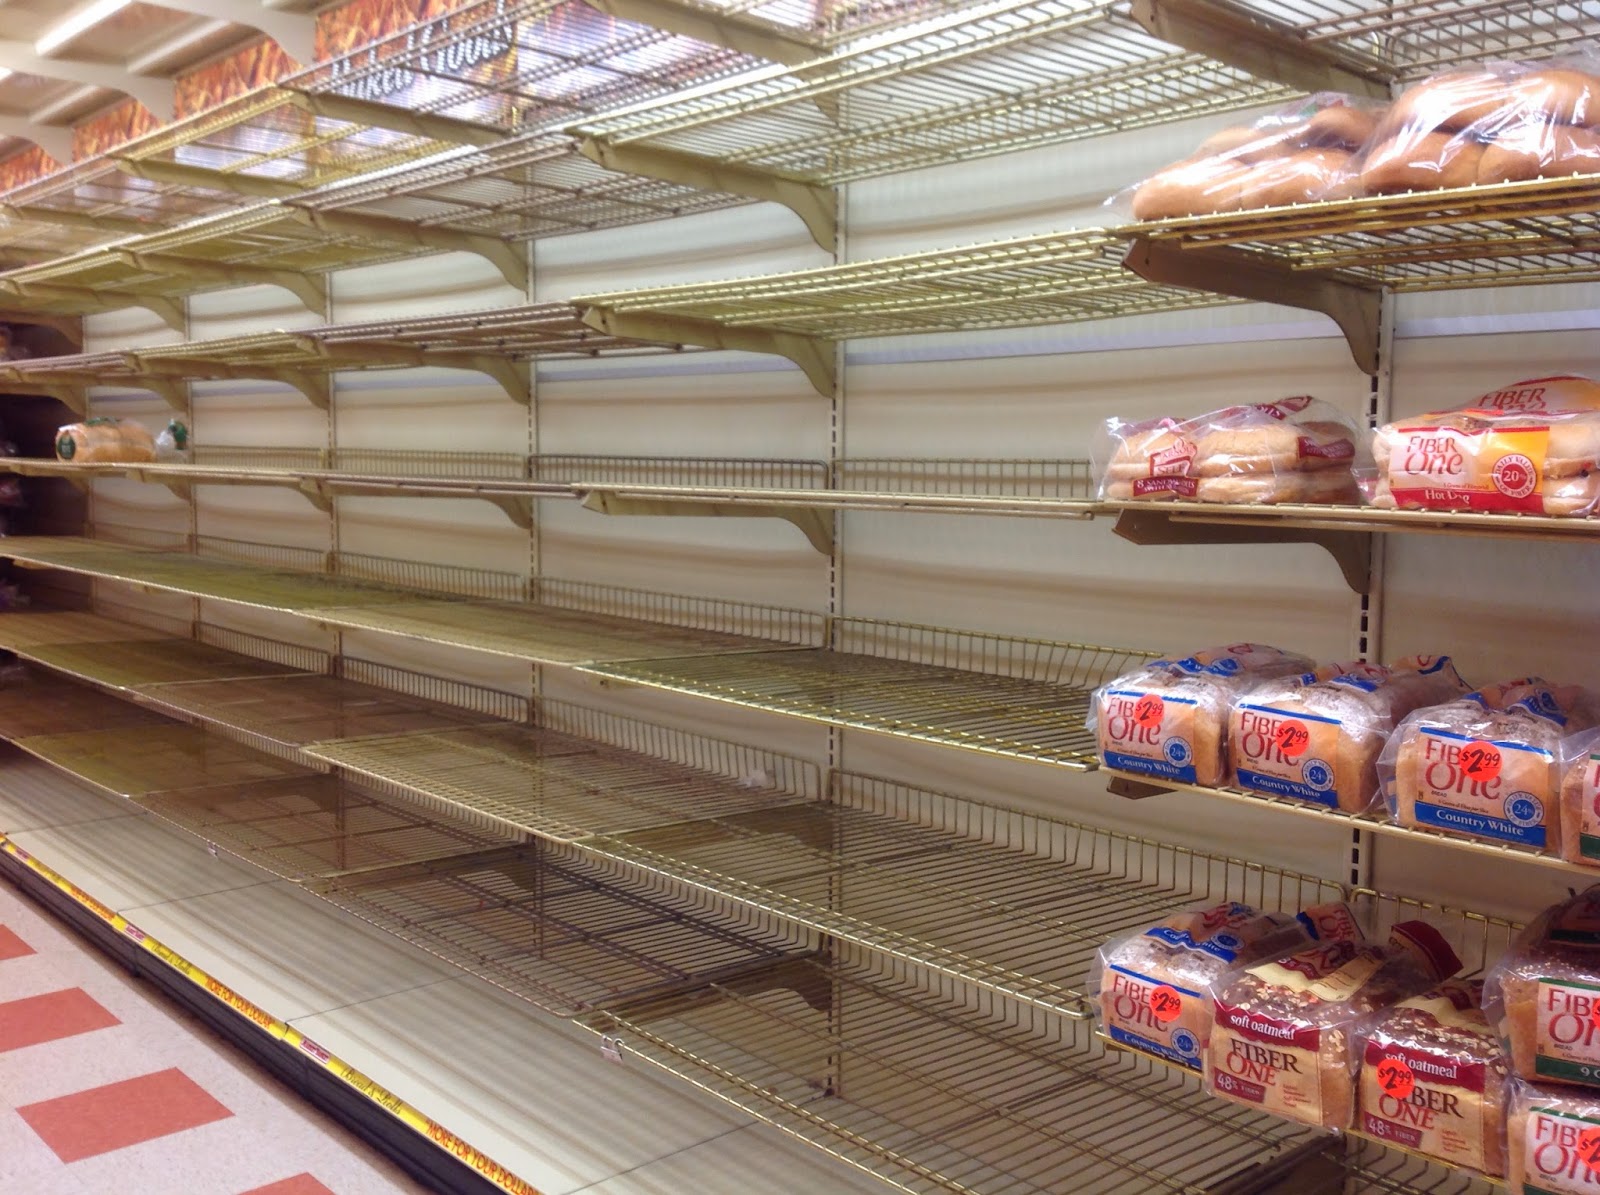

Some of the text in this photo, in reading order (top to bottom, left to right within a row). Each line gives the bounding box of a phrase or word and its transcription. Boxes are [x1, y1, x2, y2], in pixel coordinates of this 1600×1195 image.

[1478, 387, 1546, 407] FIBER
[1406, 435, 1458, 453] FIBER
[1404, 452, 1464, 475] One
[1425, 489, 1446, 500] Hot
[1107, 697, 1134, 717] FIB
[1108, 715, 1161, 745] One
[1241, 712, 1282, 737] FIBE
[1425, 738, 1462, 765] FIB
[1117, 756, 1181, 774] Country White
[1252, 775, 1291, 792] Country
[1291, 784, 1320, 797] White
[1425, 761, 1502, 800] One
[1436, 809, 1525, 836] Country White
[1113, 974, 1150, 1004] FIBE
[1548, 987, 1591, 1017] FIB
[1230, 1014, 1296, 1040] soft oatmeal
[1226, 1051, 1279, 1086] ONE
[1230, 1038, 1304, 1075] FIBER
[1408, 1059, 1457, 1079] oatmeal
[1217, 1073, 1239, 1091] 48%
[1580, 1066, 1590, 1077] 9
[1378, 1093, 1438, 1130] ONE
[1403, 1086, 1465, 1119] BER
[1369, 1118, 1391, 1136] 48%
[1536, 1115, 1577, 1147] FIB
[451, 1138, 471, 1161] FOR
[471, 1150, 497, 1180] YOUR
[1534, 1142, 1600, 1185] On
